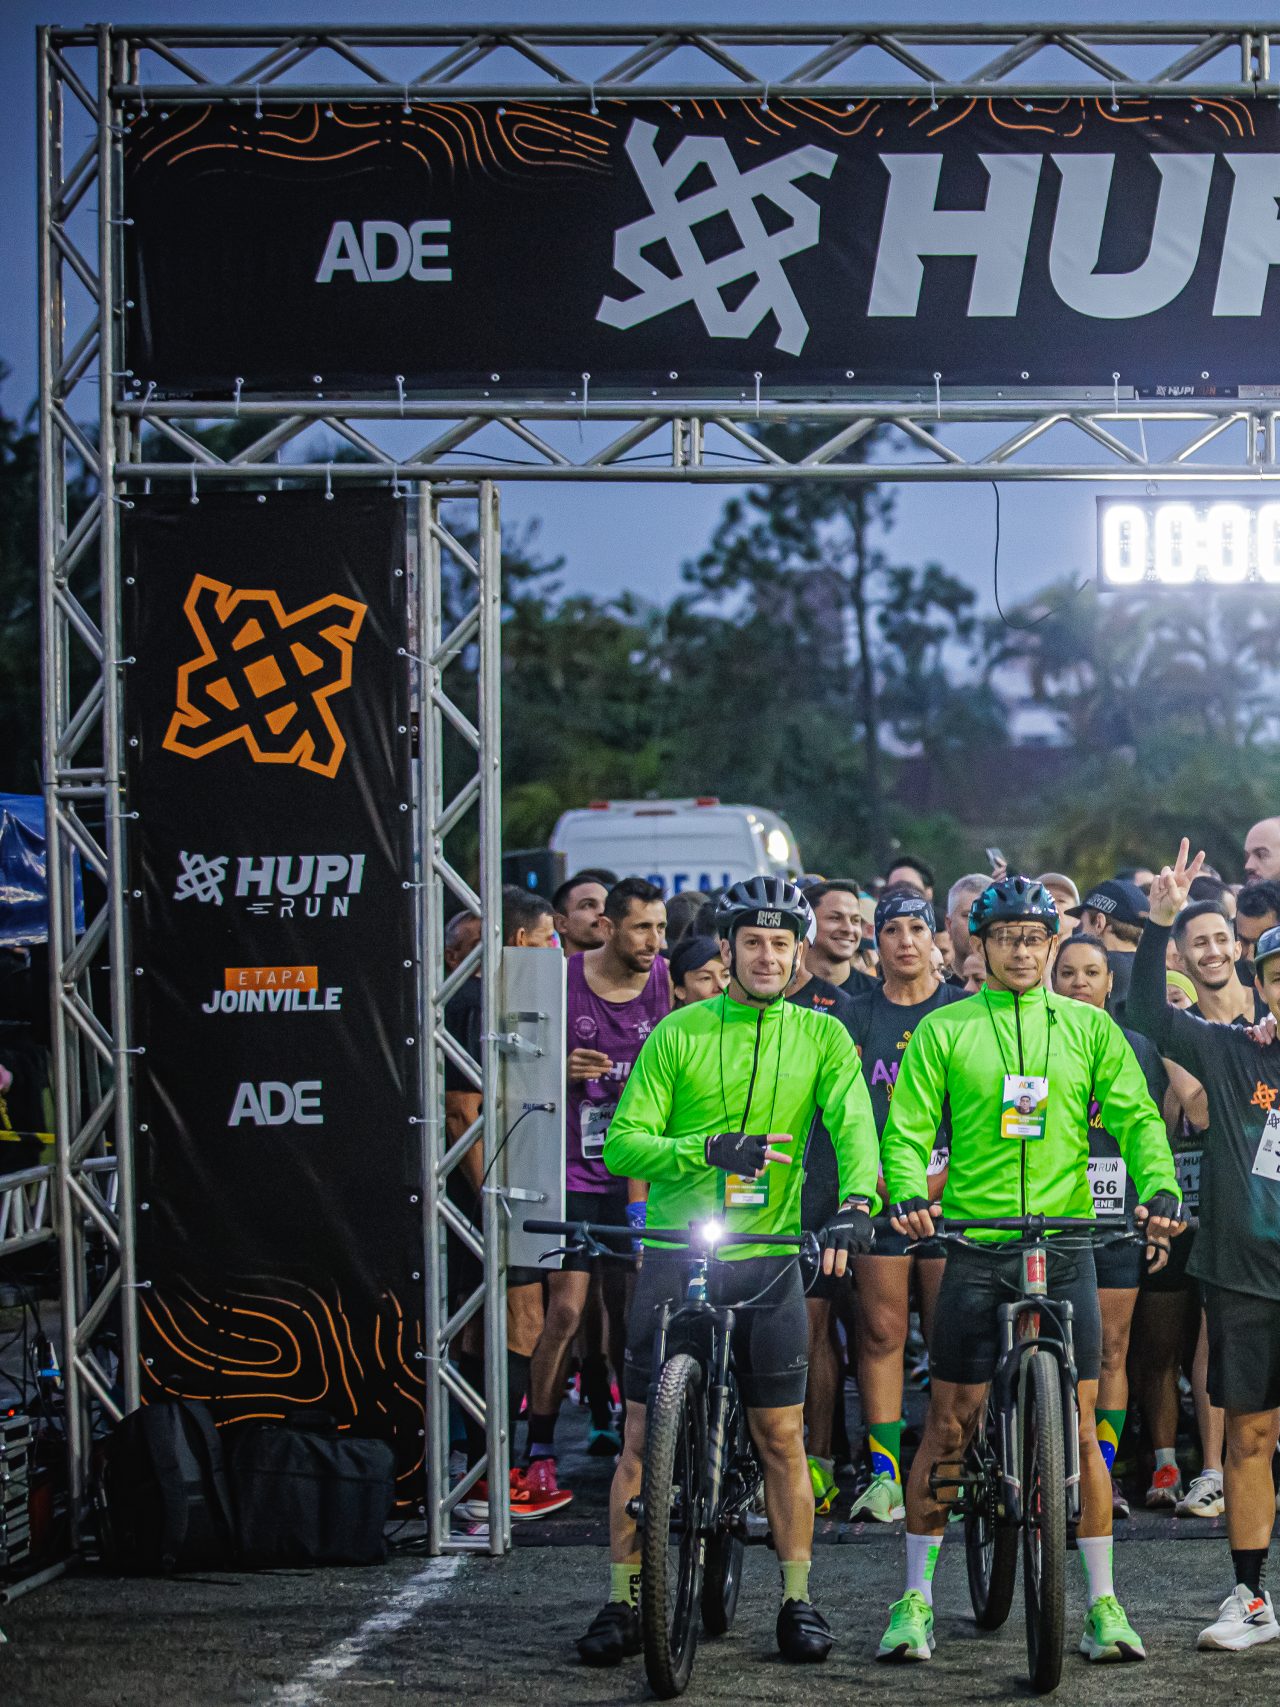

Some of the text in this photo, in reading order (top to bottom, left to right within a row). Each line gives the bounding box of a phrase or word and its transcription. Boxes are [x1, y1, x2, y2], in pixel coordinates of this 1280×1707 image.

[316, 220, 452, 283] ADE
[234, 854, 366, 896] HUPI
[280, 897, 349, 918] RUN
[238, 970, 307, 986] ETAPA
[202, 987, 343, 1014] JOINVILLE
[227, 1080, 323, 1127] ADE
[1098, 1161, 1119, 1173] RUN
